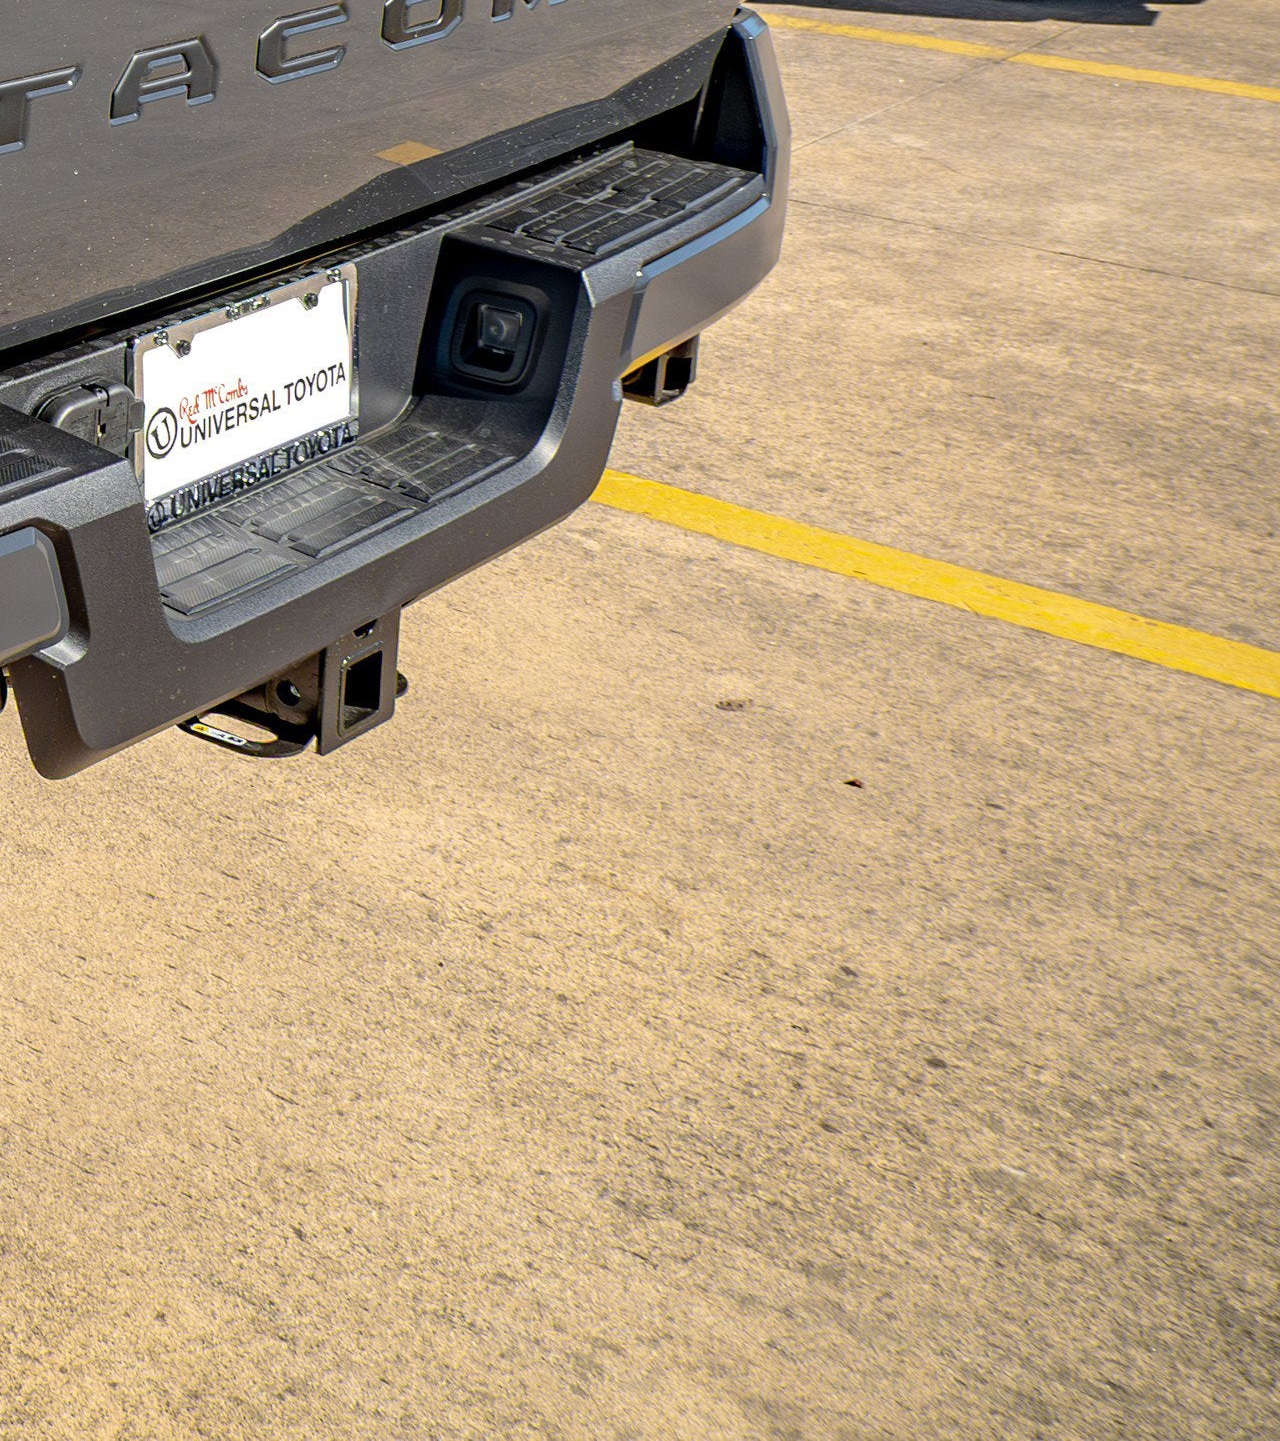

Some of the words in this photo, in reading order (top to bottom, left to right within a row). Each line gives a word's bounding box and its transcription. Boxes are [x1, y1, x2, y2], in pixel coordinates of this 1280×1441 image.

[180, 389, 281, 449] UNIVERSAL
[283, 361, 346, 406] TOYOTA
[170, 452, 281, 519] UNIVERSAL
[282, 421, 354, 470] TOYOTA
